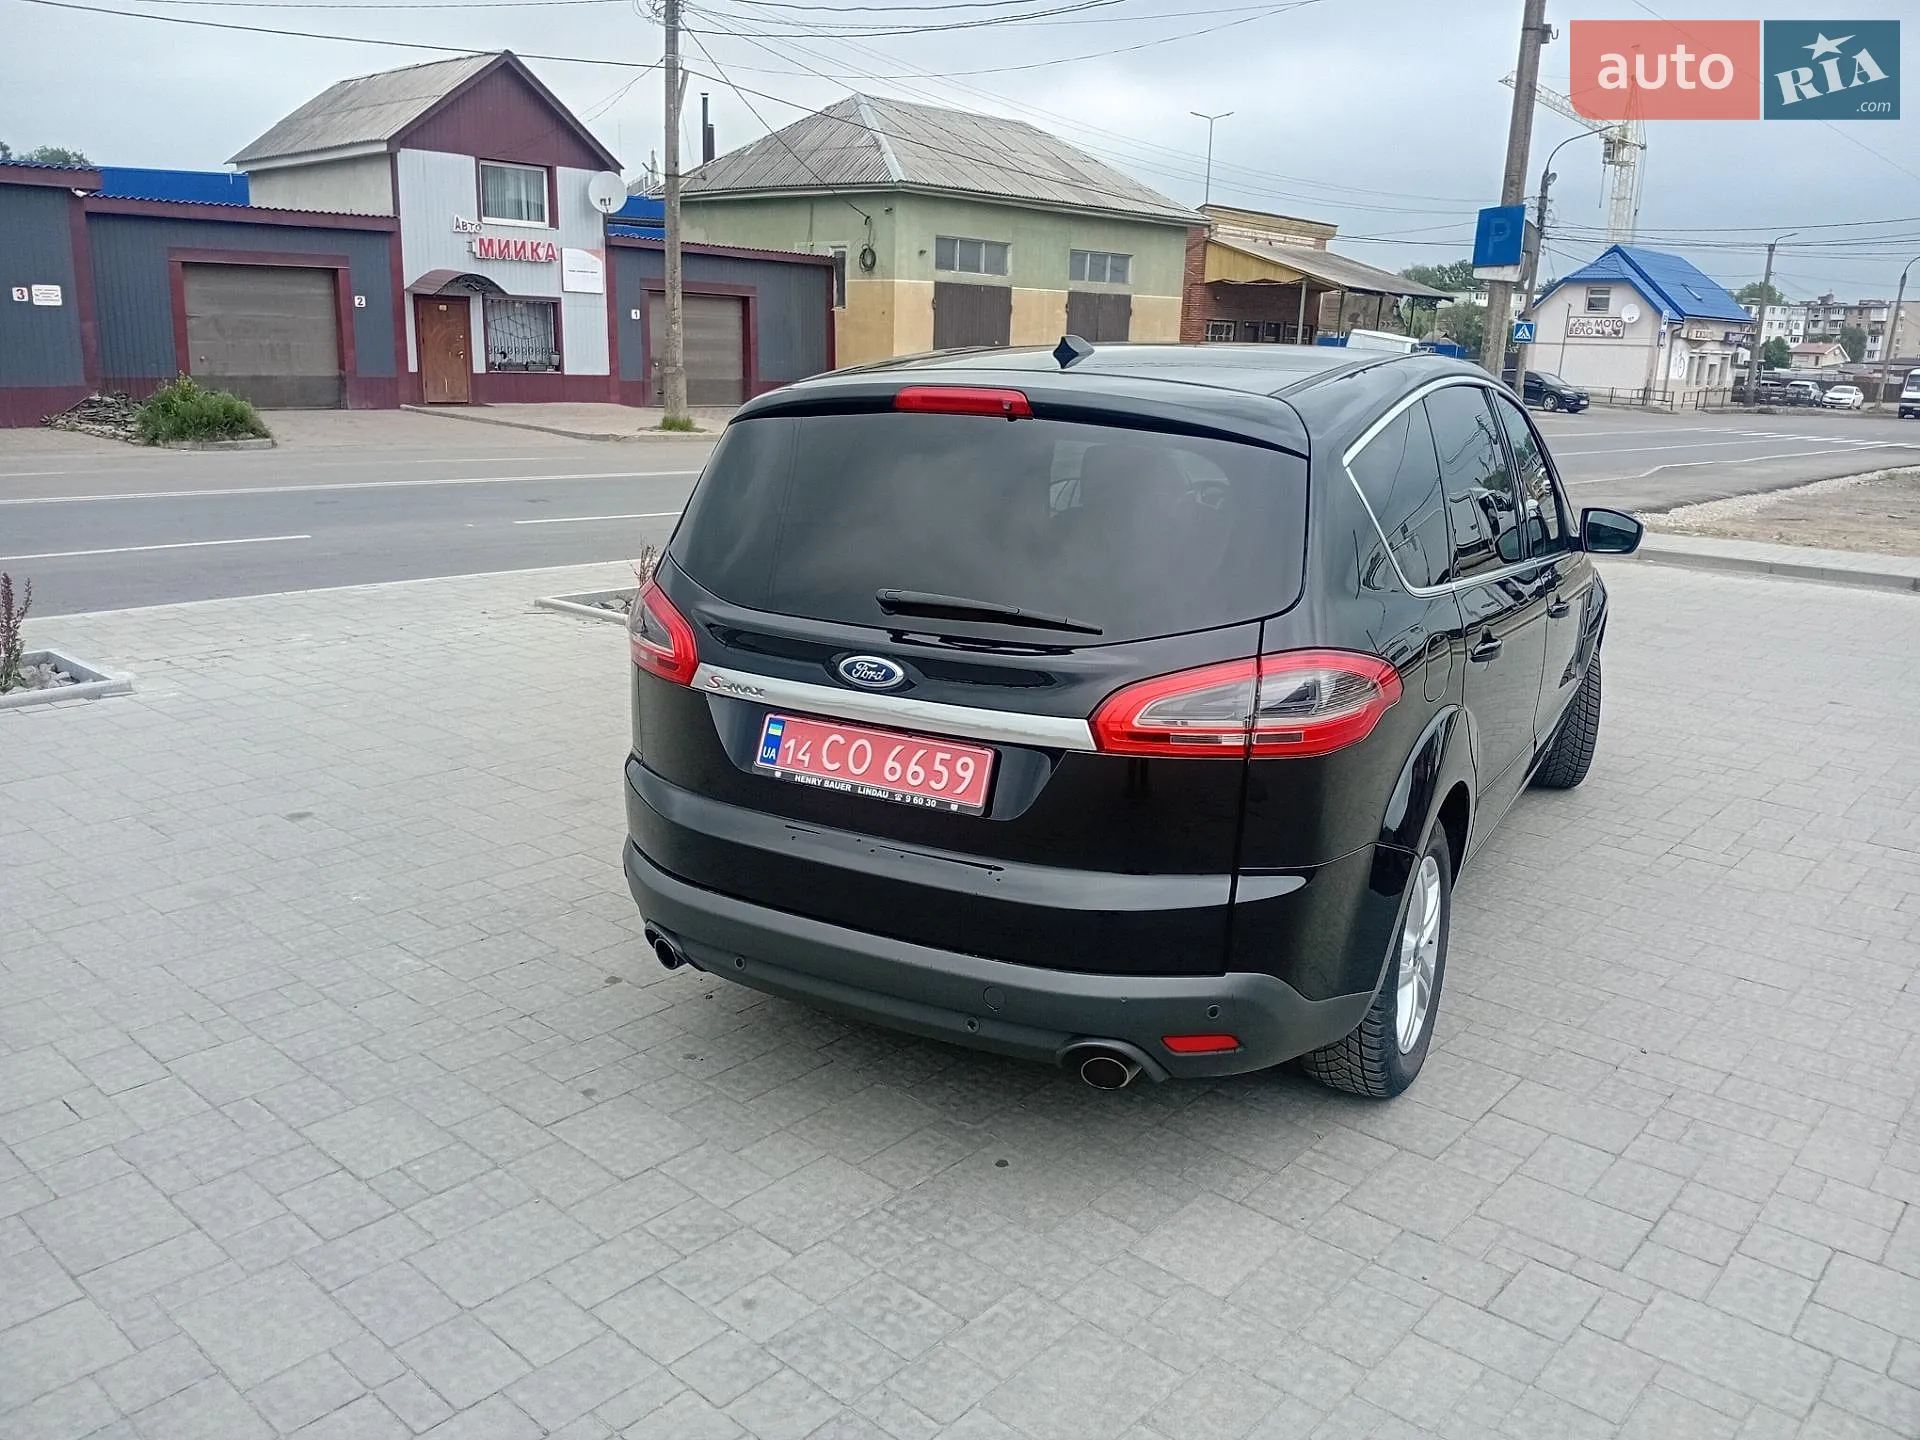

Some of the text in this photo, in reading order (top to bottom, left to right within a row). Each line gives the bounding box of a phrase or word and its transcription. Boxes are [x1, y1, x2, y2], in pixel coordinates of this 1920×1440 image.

[16, 288, 25, 300] 3
[357, 297, 364, 306] 2
[852, 661, 886, 682] Ford
[762, 745, 776, 760] UA
[784, 733, 975, 795] 14 CO 6659
[794, 774, 937, 808] HENRY BAUER LINDAU 9 60 30
